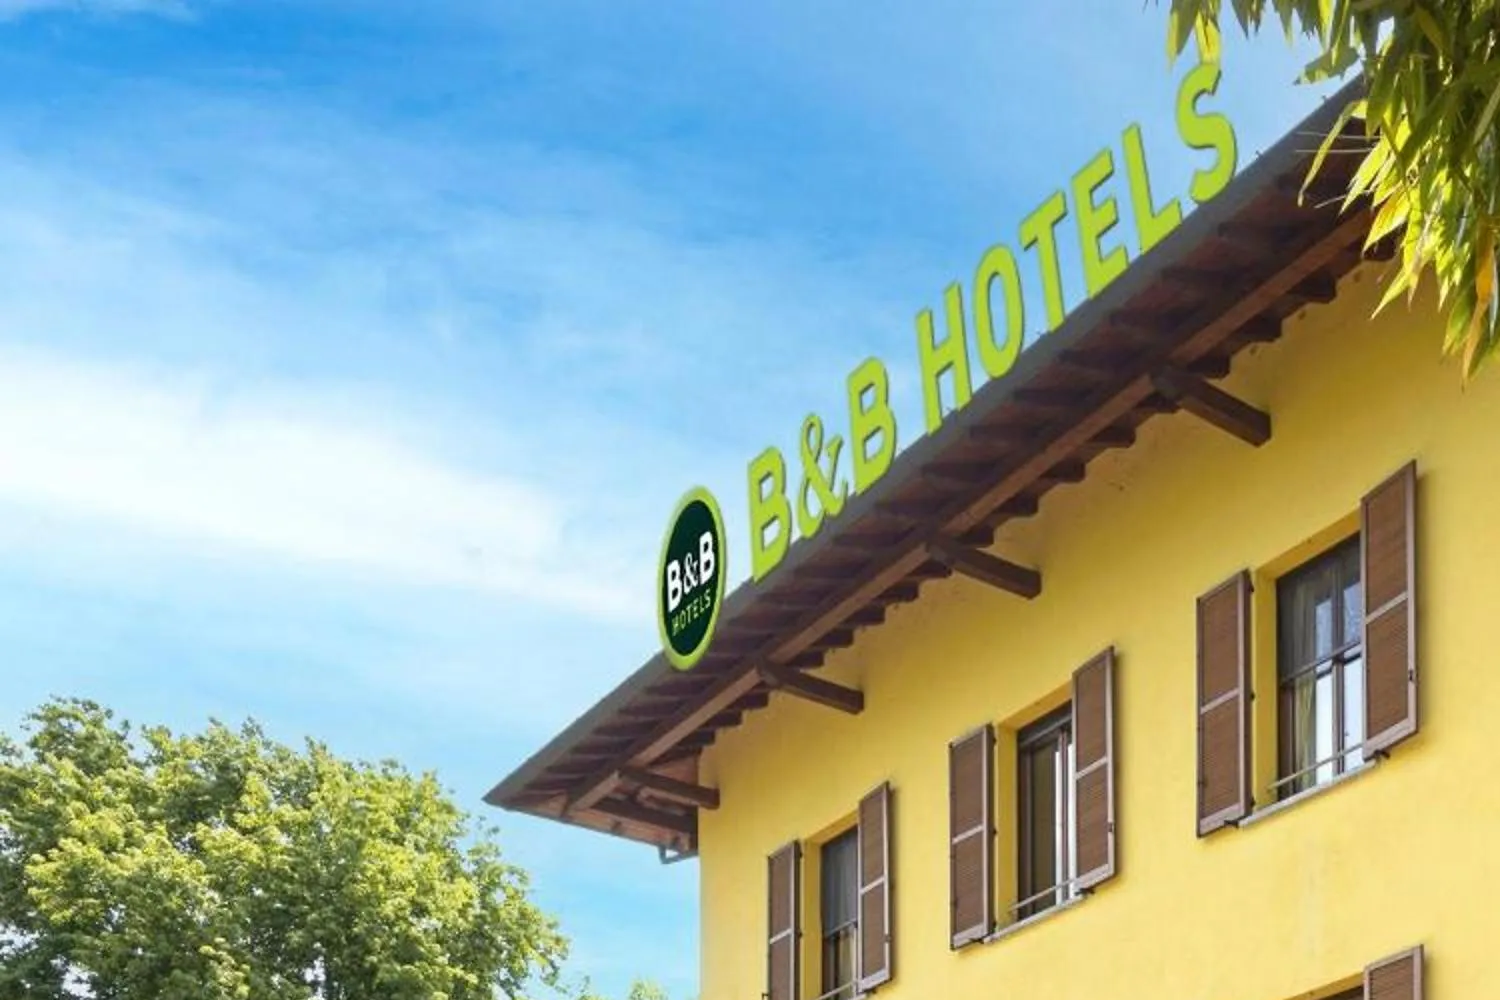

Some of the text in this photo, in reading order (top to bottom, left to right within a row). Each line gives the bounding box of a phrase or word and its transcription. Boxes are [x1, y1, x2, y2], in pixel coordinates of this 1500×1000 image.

[748, 63, 1238, 583] B&B HOTELS
[667, 531, 715, 612] B&B
[672, 588, 711, 636] HOTELS
